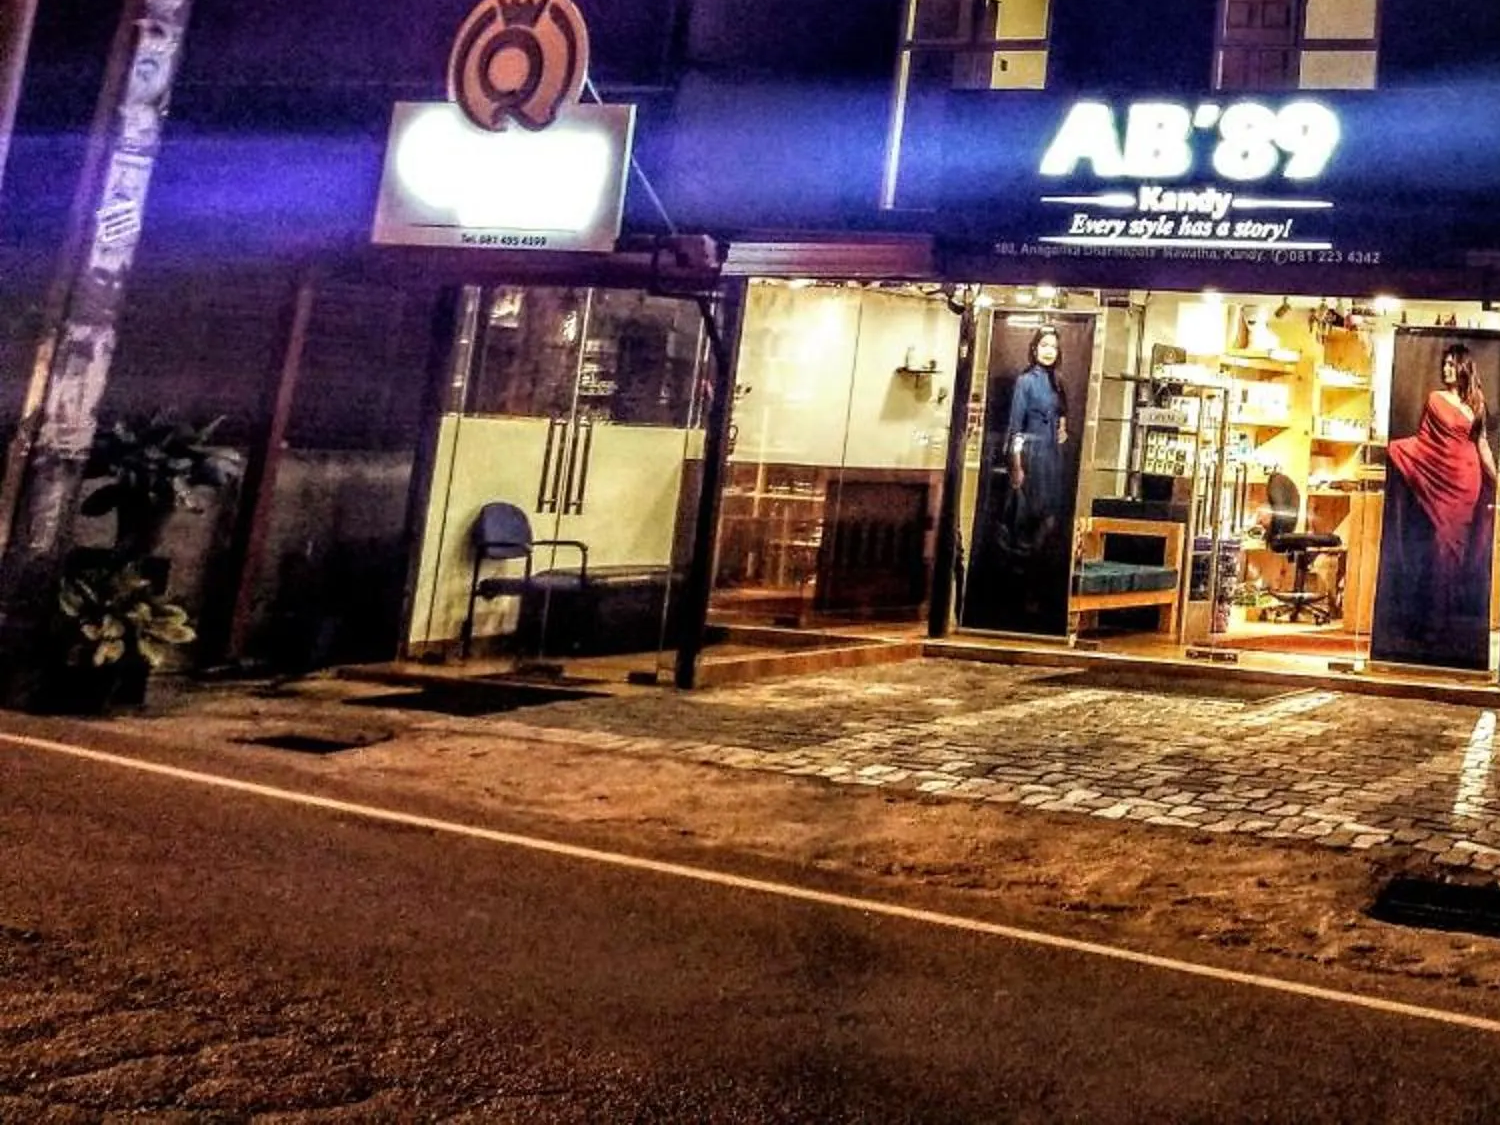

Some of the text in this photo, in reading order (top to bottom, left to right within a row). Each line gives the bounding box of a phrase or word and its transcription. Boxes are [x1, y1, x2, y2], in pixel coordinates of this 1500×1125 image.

[1039, 102, 1341, 180] AB'89
[1138, 185, 1233, 220] Kandy
[1069, 213, 1293, 242] Every style has a story!
[1318, 251, 1343, 263] 223
